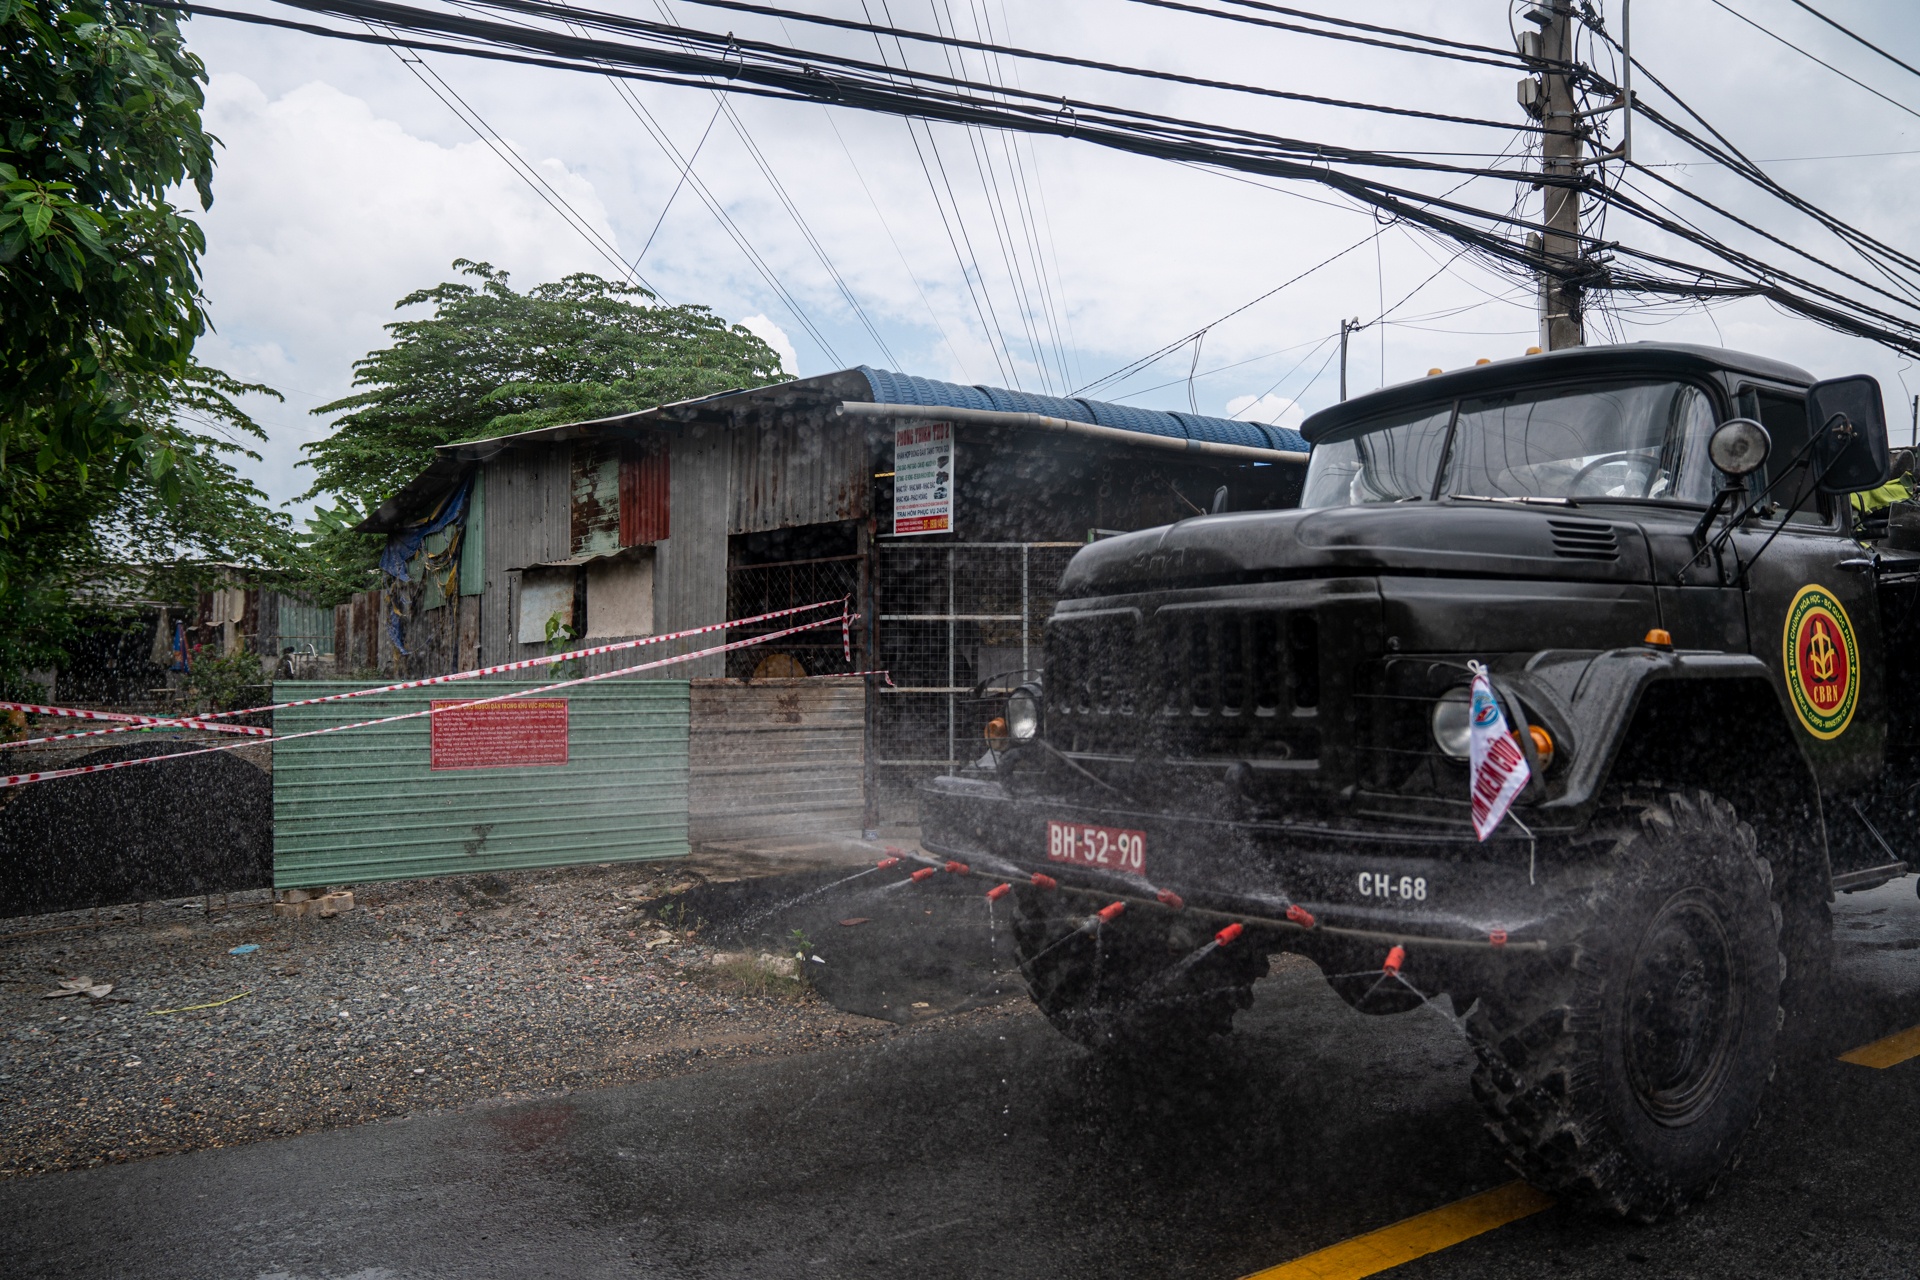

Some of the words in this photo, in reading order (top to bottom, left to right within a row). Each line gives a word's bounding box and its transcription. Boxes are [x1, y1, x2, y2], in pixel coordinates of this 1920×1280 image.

[1792, 678, 1809, 716] CHEMICAL
[1808, 711, 1823, 728] CORPS
[1813, 685, 1838, 703] CBRN
[1051, 825, 1142, 868] BH-52-90
[1359, 872, 1427, 901] CH-68
